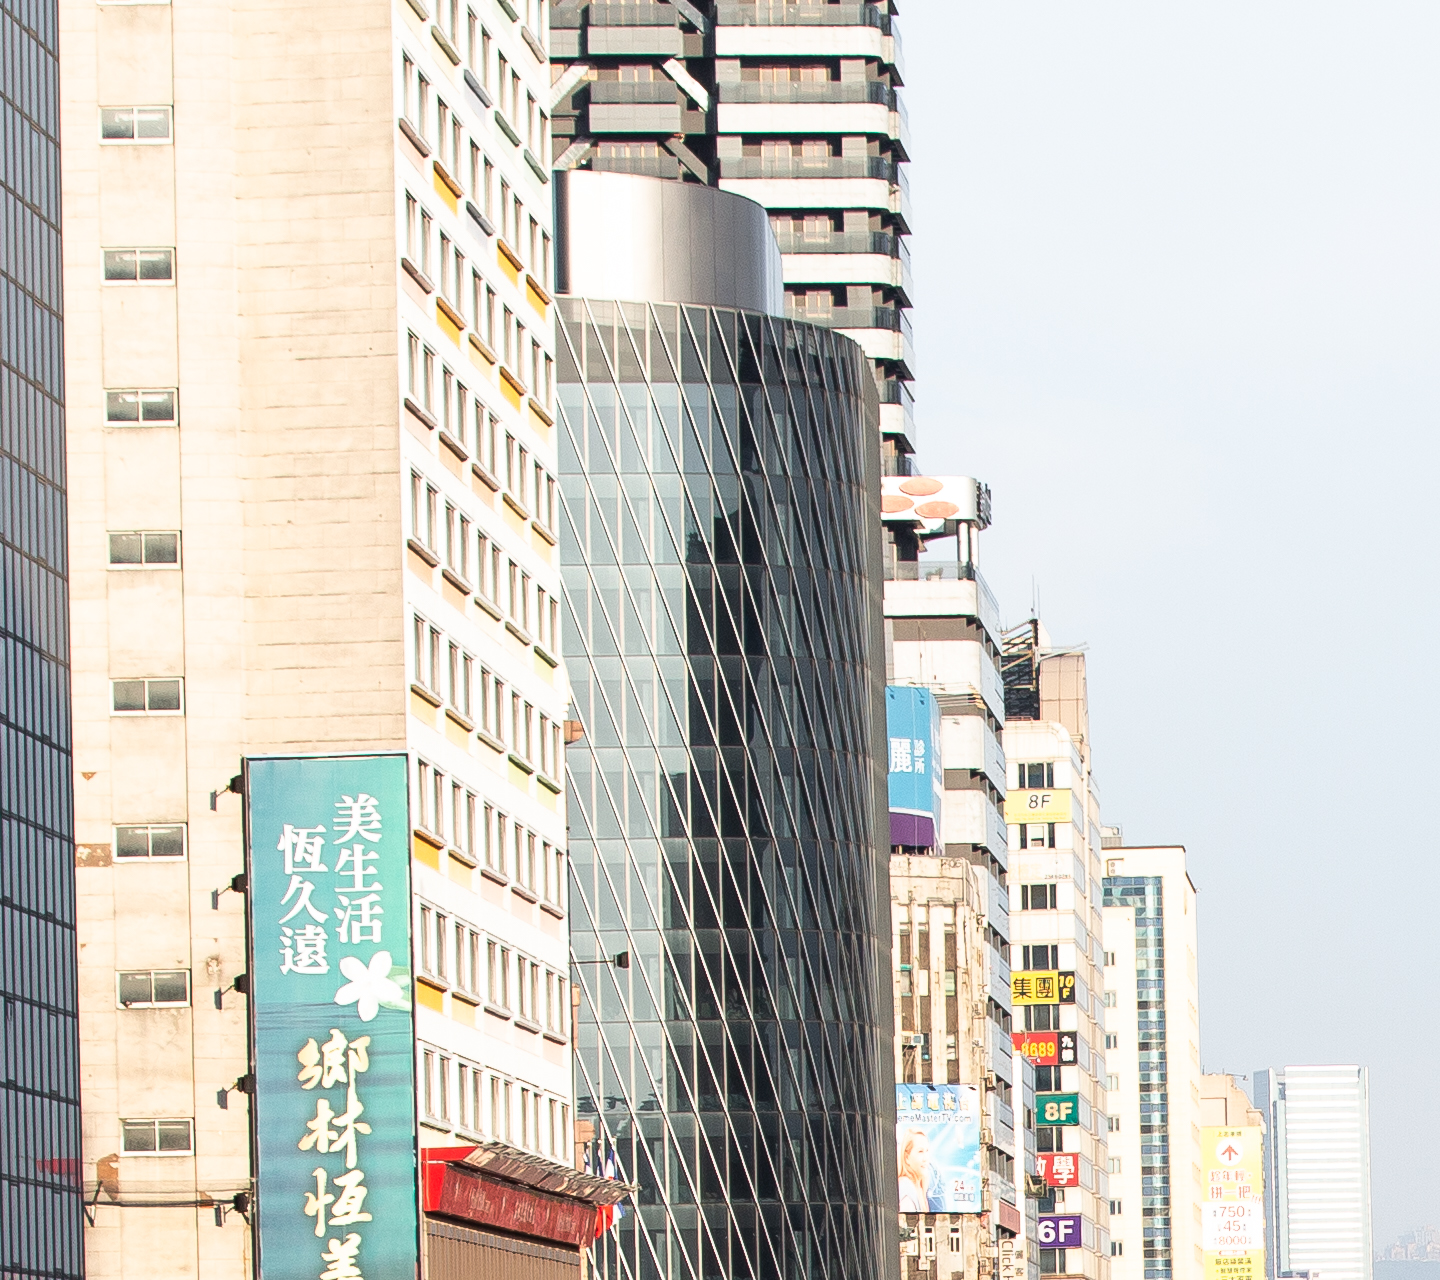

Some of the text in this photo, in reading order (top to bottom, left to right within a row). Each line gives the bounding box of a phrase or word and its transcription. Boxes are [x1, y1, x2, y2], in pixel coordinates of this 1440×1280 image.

[914, 739, 925, 775] 診所
[1028, 794, 1052, 809] 8F
[333, 793, 383, 944] 美生活
[277, 824, 331, 976] 恆久遠
[1012, 977, 1053, 999] 集團
[1059, 976, 1074, 988] 10
[1044, 1102, 1073, 1122] 8F
[1038, 1220, 1074, 1243] 6F
[1223, 1220, 1241, 1232] 45
[1001, 1240, 1015, 1272] Click
